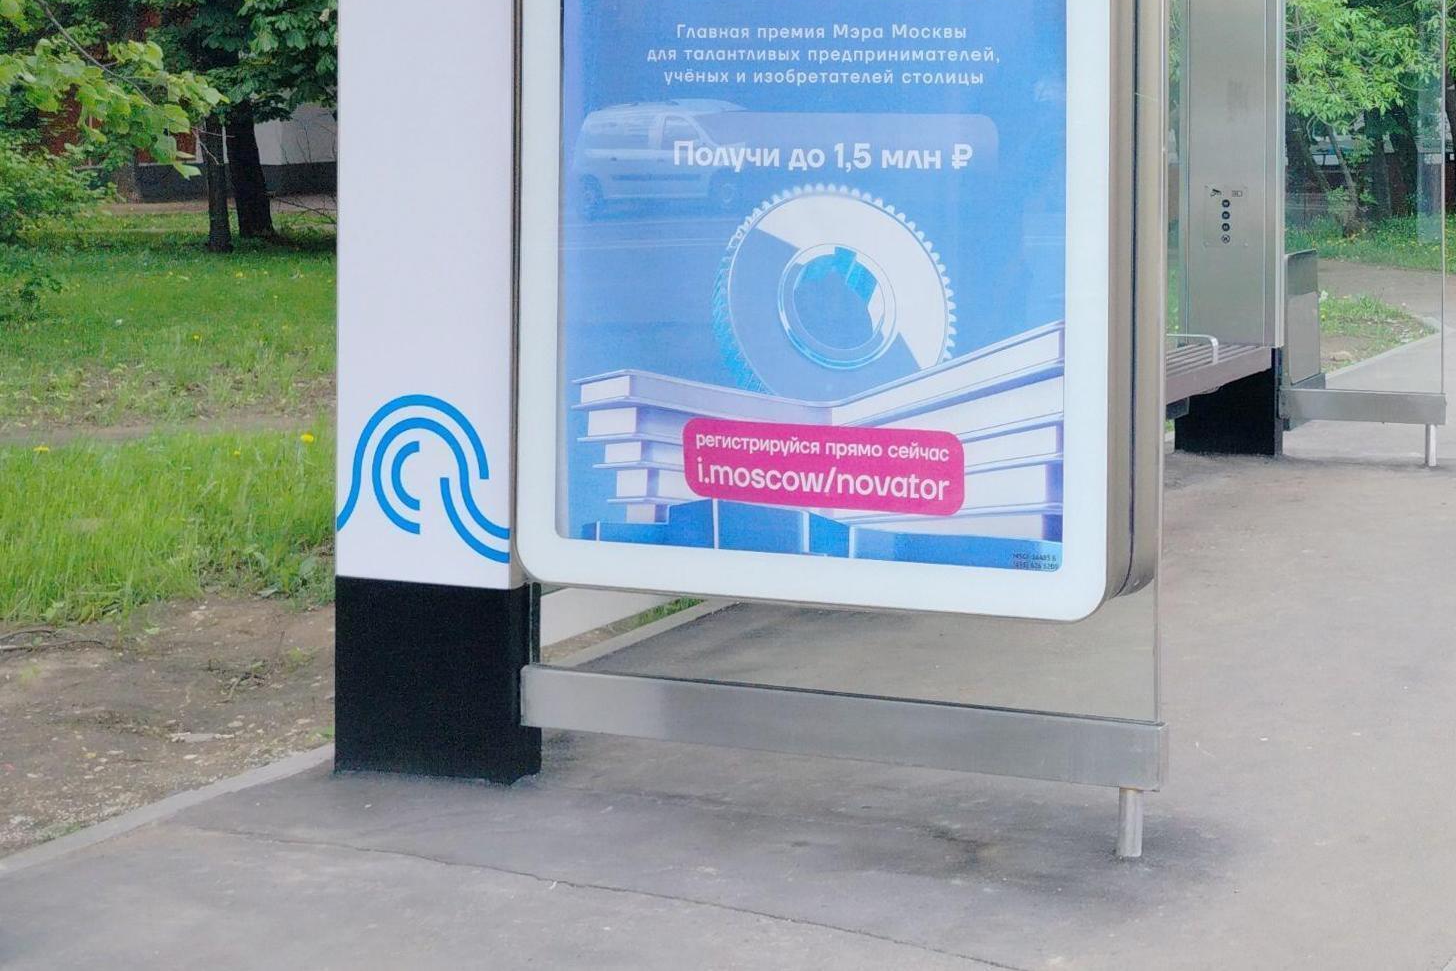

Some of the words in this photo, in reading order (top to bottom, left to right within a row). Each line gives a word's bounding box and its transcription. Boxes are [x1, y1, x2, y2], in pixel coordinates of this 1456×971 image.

[676, 24, 750, 40] Главная
[757, 26, 825, 42] премия
[833, 24, 884, 42] Мэра
[892, 23, 967, 40] Москвы
[647, 49, 677, 63] для
[684, 47, 801, 62] талантливых
[807, 45, 1001, 65] предпринимателей,
[664, 67, 729, 85] учёных
[736, 71, 746, 83] и
[753, 67, 894, 86] изобретателей
[901, 71, 984, 86] столицы
[672, 140, 781, 173] Получи
[788, 145, 826, 172] до
[833, 142, 873, 173] 1,5
[880, 148, 942, 170] млн
[696, 433, 820, 458] регистрируйся
[825, 441, 883, 460] прямо
[887, 442, 950, 462] сейчас
[696, 457, 951, 501] i.moscow/novator
